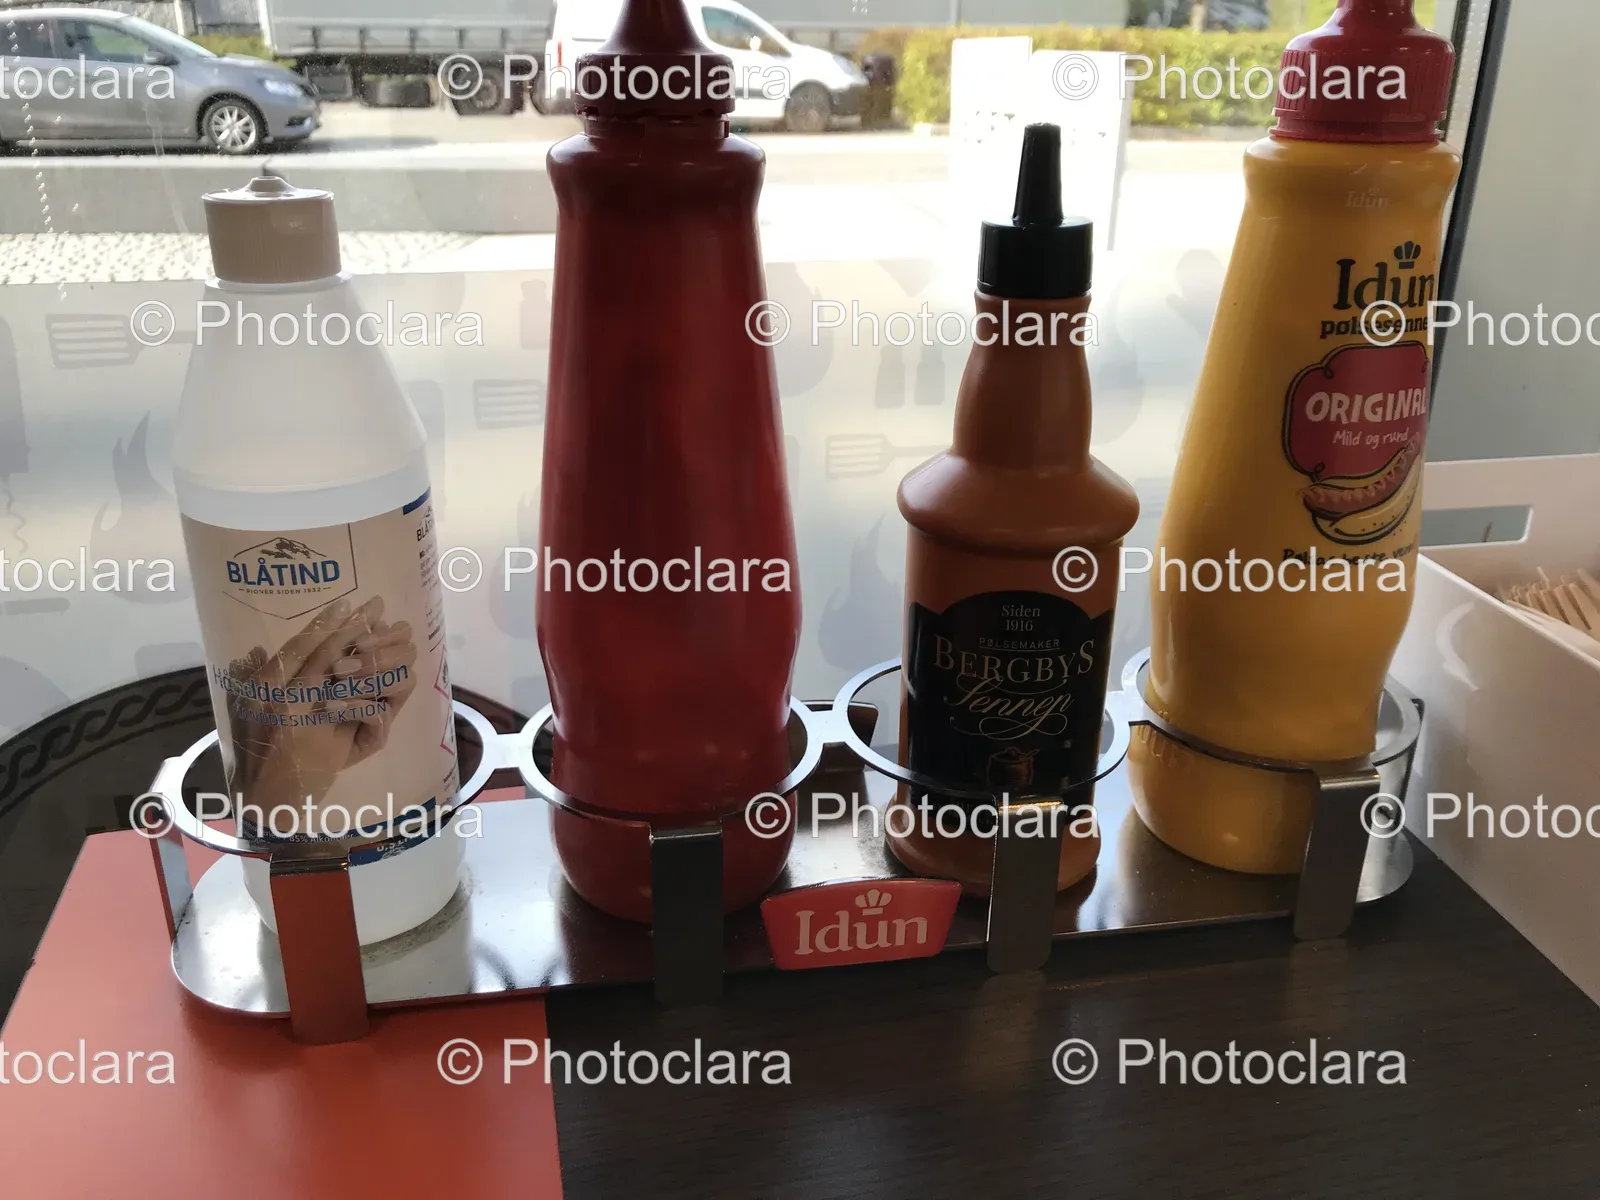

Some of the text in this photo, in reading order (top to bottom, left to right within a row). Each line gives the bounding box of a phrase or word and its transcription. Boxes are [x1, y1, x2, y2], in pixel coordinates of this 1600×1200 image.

[1333, 259, 1434, 310] Idun
[1306, 388, 1426, 424] ORIGINAL
[1333, 427, 1409, 449] Mild og rund
[226, 558, 340, 586] BLÅTIND
[1001, 604, 1041, 618] Siden
[1005, 619, 1034, 632] 1916
[934, 634, 1095, 683] BERGBYS
[979, 637, 1061, 649] PØLSEMAKER
[943, 674, 1075, 740] Sennep
[794, 910, 928, 956] Idun
